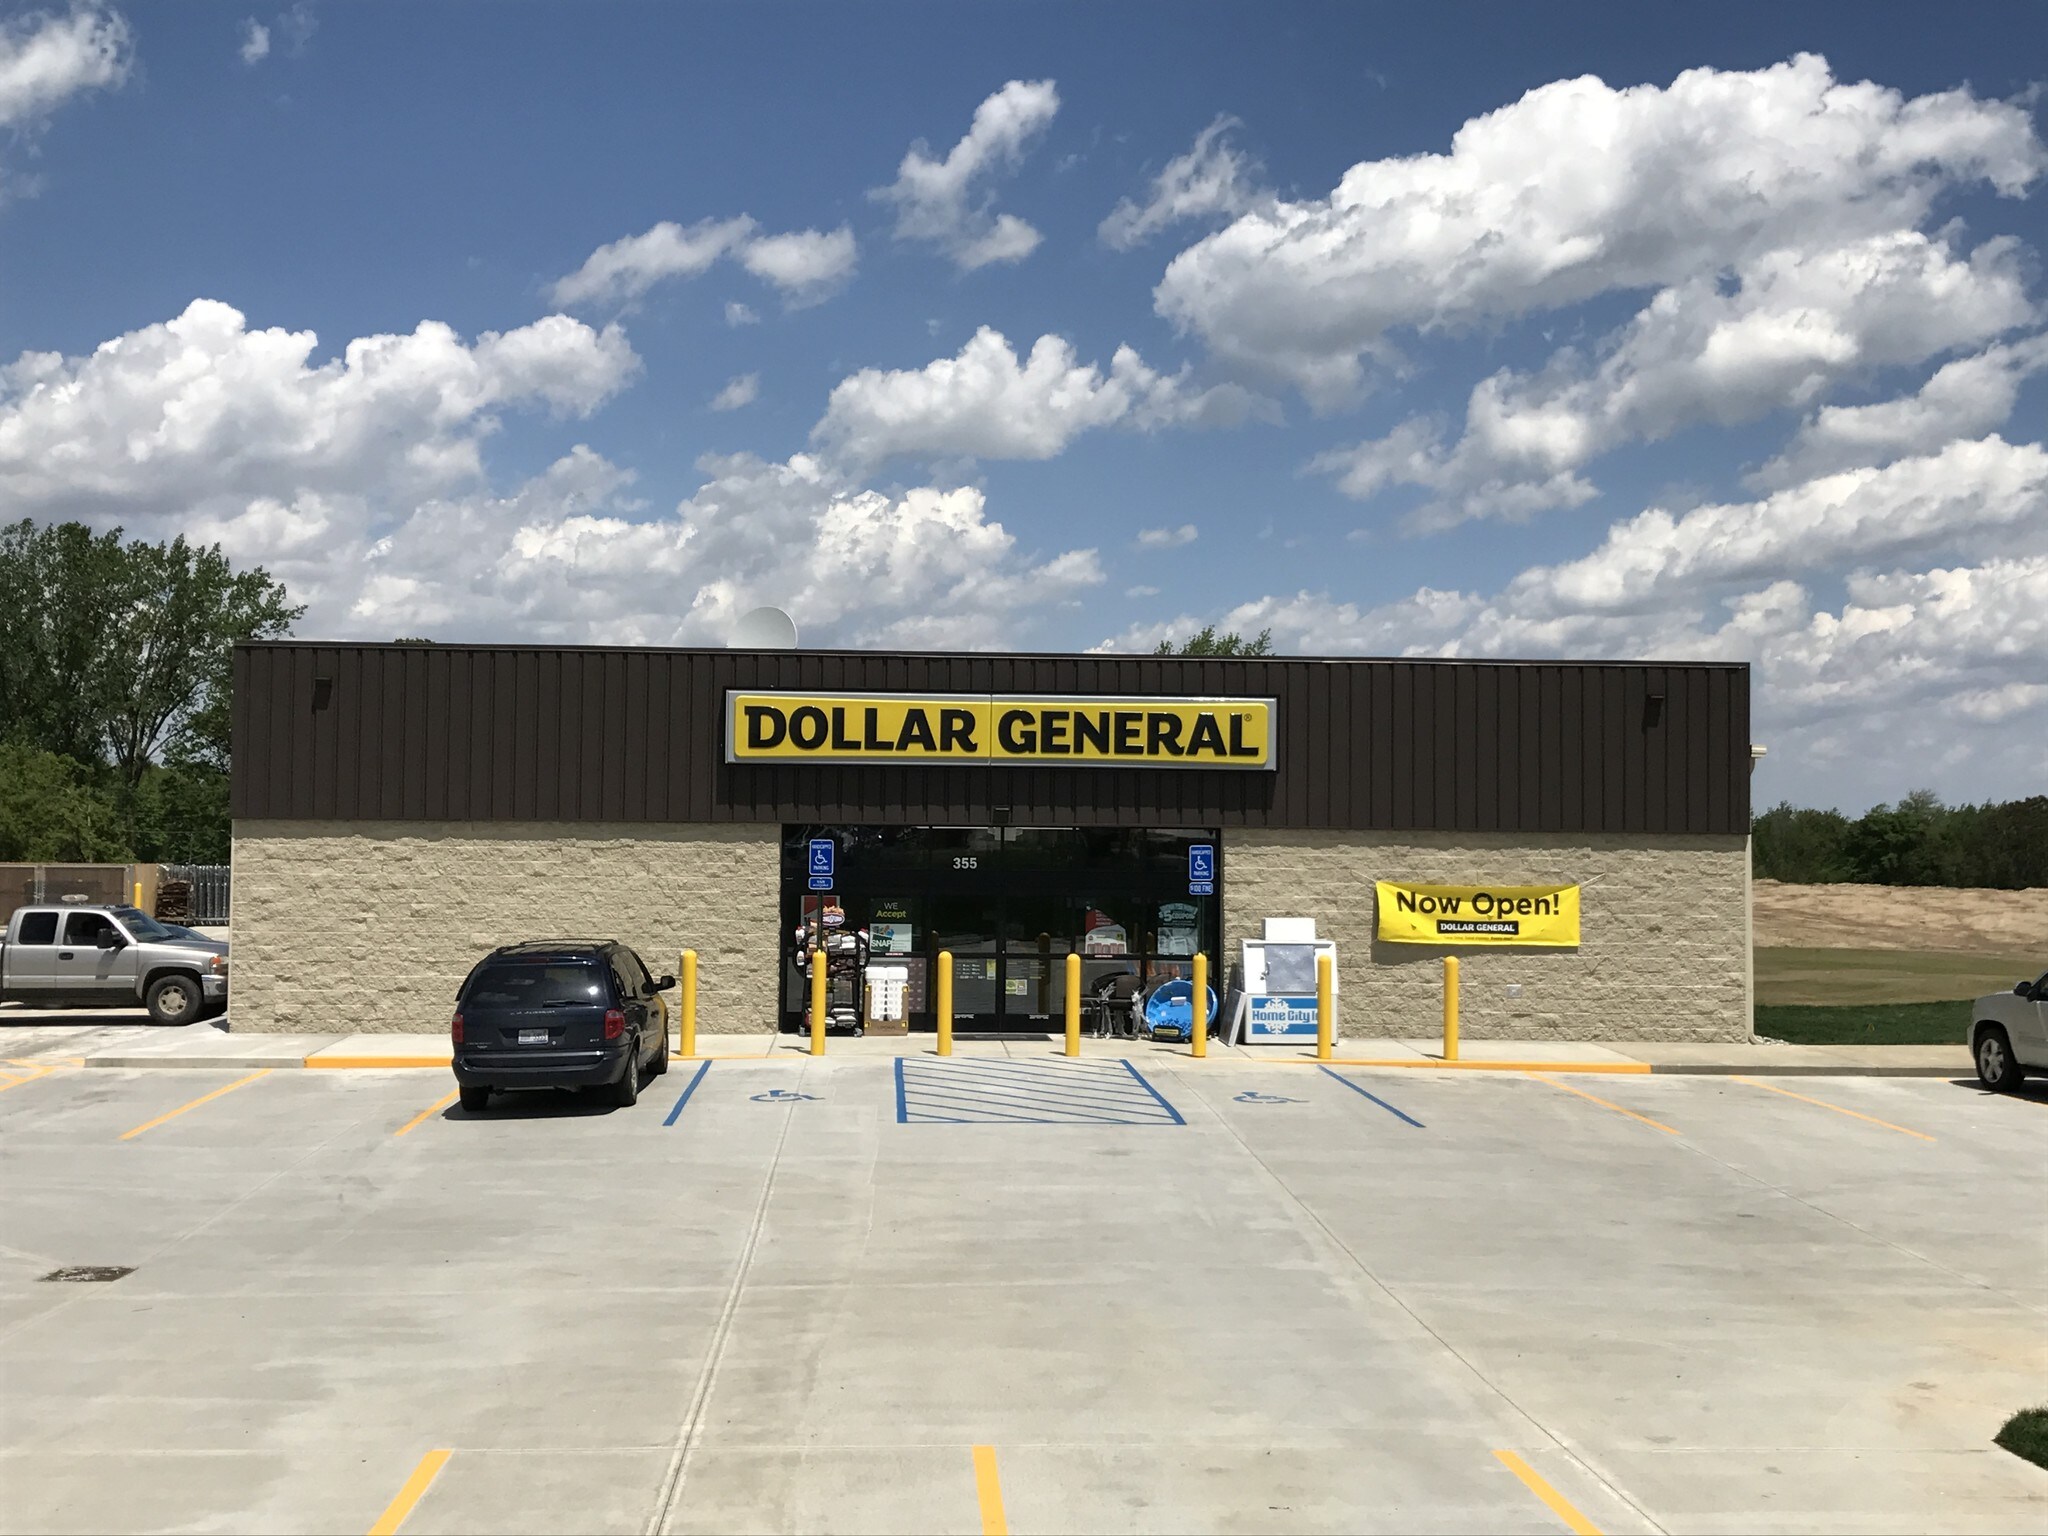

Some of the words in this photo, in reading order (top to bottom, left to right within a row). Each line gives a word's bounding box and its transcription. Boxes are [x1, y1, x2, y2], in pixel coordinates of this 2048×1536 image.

[744, 705, 978, 753] DOLLAR
[998, 709, 1260, 757] GENERAL
[953, 857, 978, 869] 355
[884, 902, 898, 910] WE
[1396, 892, 1461, 914] Now
[1472, 892, 1560, 919] Open!
[876, 910, 907, 919] Accept
[1440, 923, 1475, 931] DOLLAR
[1476, 924, 1516, 932] GENERAL
[871, 939, 892, 948] SNAP
[1252, 1010, 1286, 1021] Home
[1287, 1010, 1311, 1023] City
